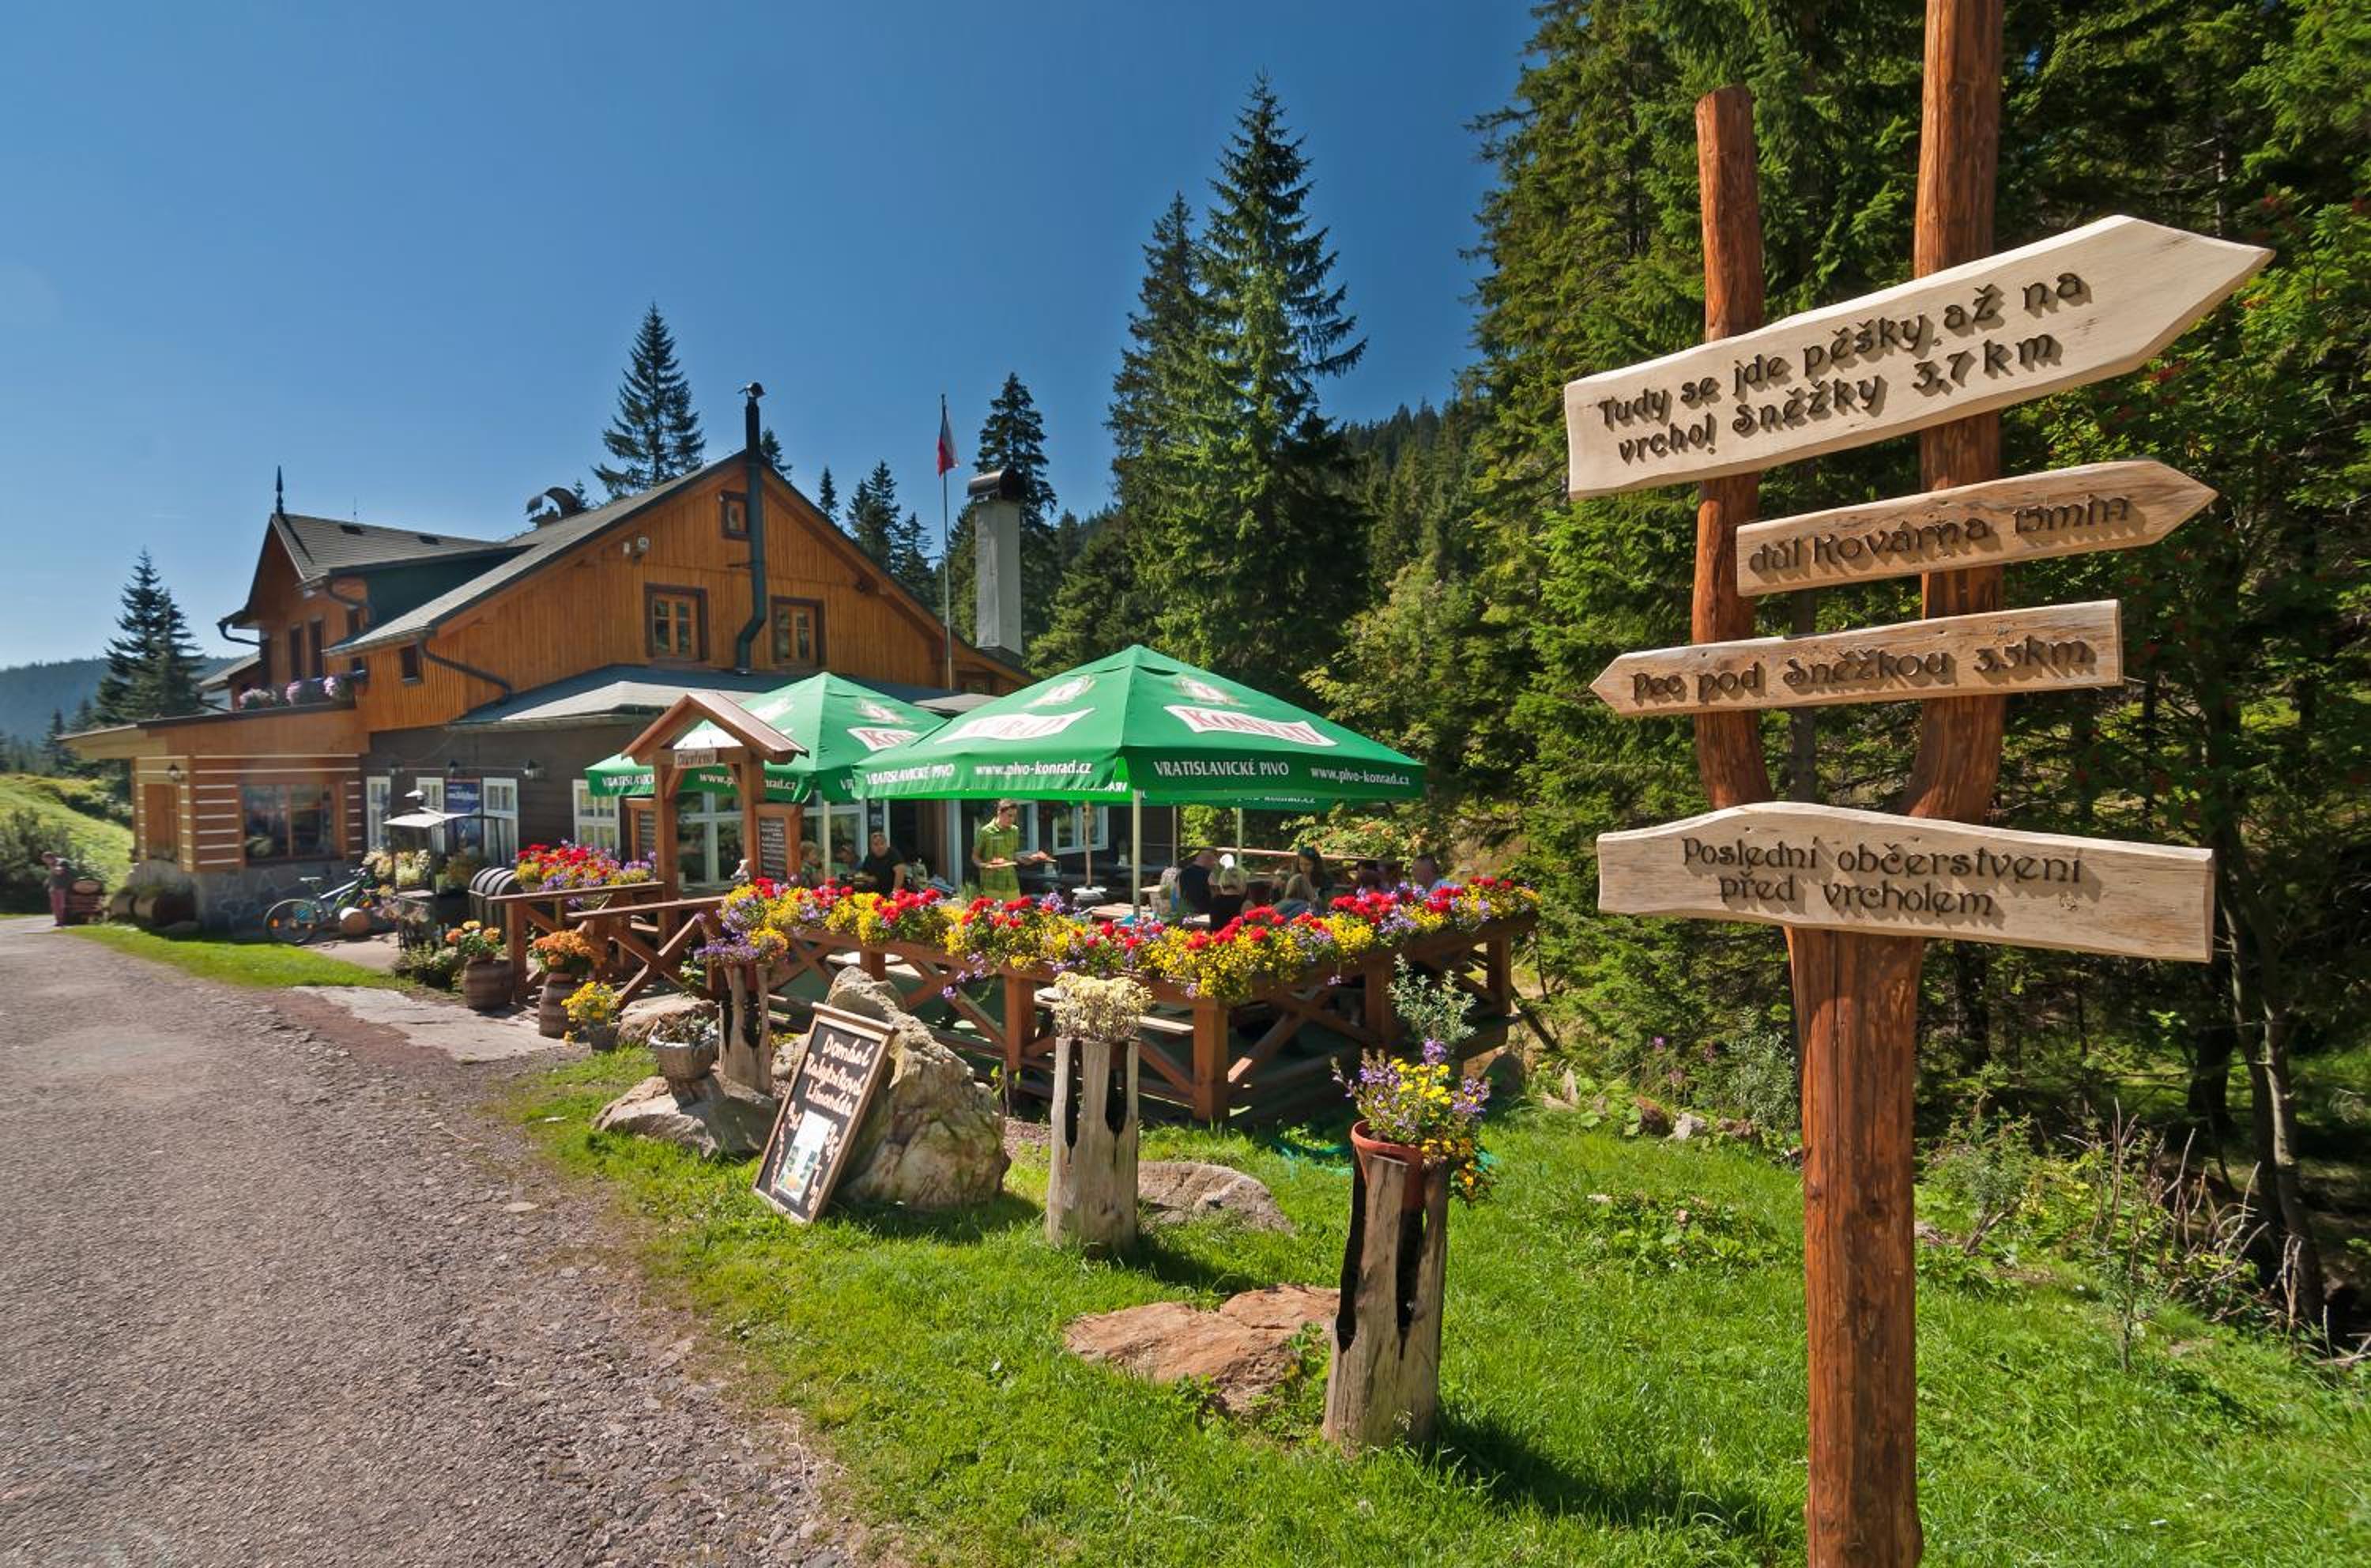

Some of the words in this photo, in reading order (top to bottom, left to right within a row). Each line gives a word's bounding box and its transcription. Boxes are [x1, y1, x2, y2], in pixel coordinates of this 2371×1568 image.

[1598, 388, 1672, 427] Tudy
[1680, 377, 1718, 405] se
[1732, 354, 1789, 398] jde
[1944, 285, 2001, 327] až
[2022, 273, 2087, 313] na
[1619, 413, 1716, 462] vrchol
[1732, 375, 1886, 436] Sněžky
[1912, 350, 1974, 395] 3,7
[1983, 334, 2061, 378] km
[1698, 662, 1762, 703] pod
[1782, 648, 1952, 688] Sněžkou
[974, 759, 1093, 781] www.pivo-konrad.cz
[1154, 759, 1257, 777] VRATISLAVICKÉ
[1260, 761, 1290, 776] PIVO
[1682, 836, 1821, 871] Poslední
[1838, 843, 2083, 884] občerstvení
[1719, 872, 1796, 903] před
[1823, 880, 1993, 917] vrcholem
